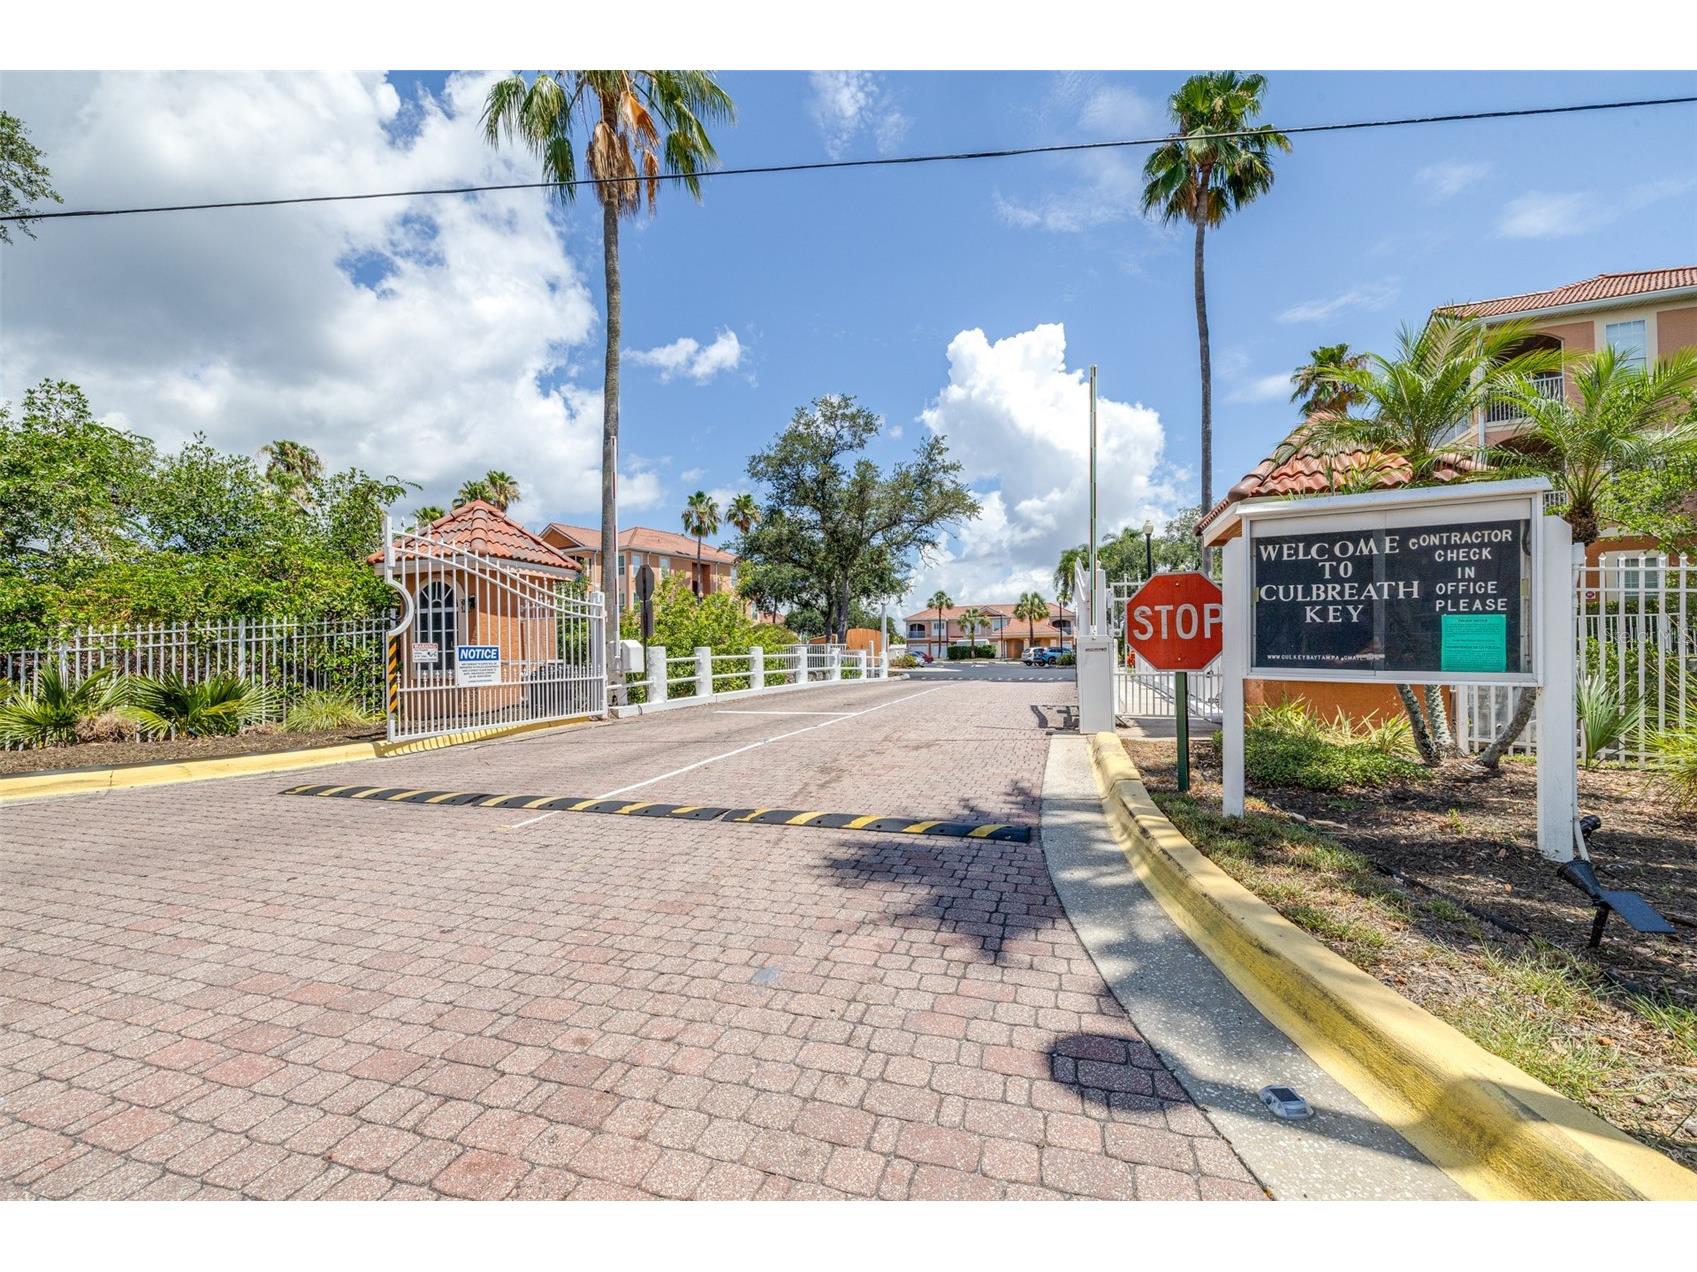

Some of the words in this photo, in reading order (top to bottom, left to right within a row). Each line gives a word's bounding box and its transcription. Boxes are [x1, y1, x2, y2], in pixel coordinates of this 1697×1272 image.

[1259, 535, 1400, 562] WELCOME
[1408, 529, 1512, 550] CONTRACTOR
[1457, 566, 1475, 579] IN
[1259, 580, 1420, 602] CULBREATH
[1304, 605, 1364, 623] KEY
[1435, 598, 1508, 612] PLEASE
[1133, 603, 1223, 641] STOP
[460, 648, 498, 660] NOTICE
